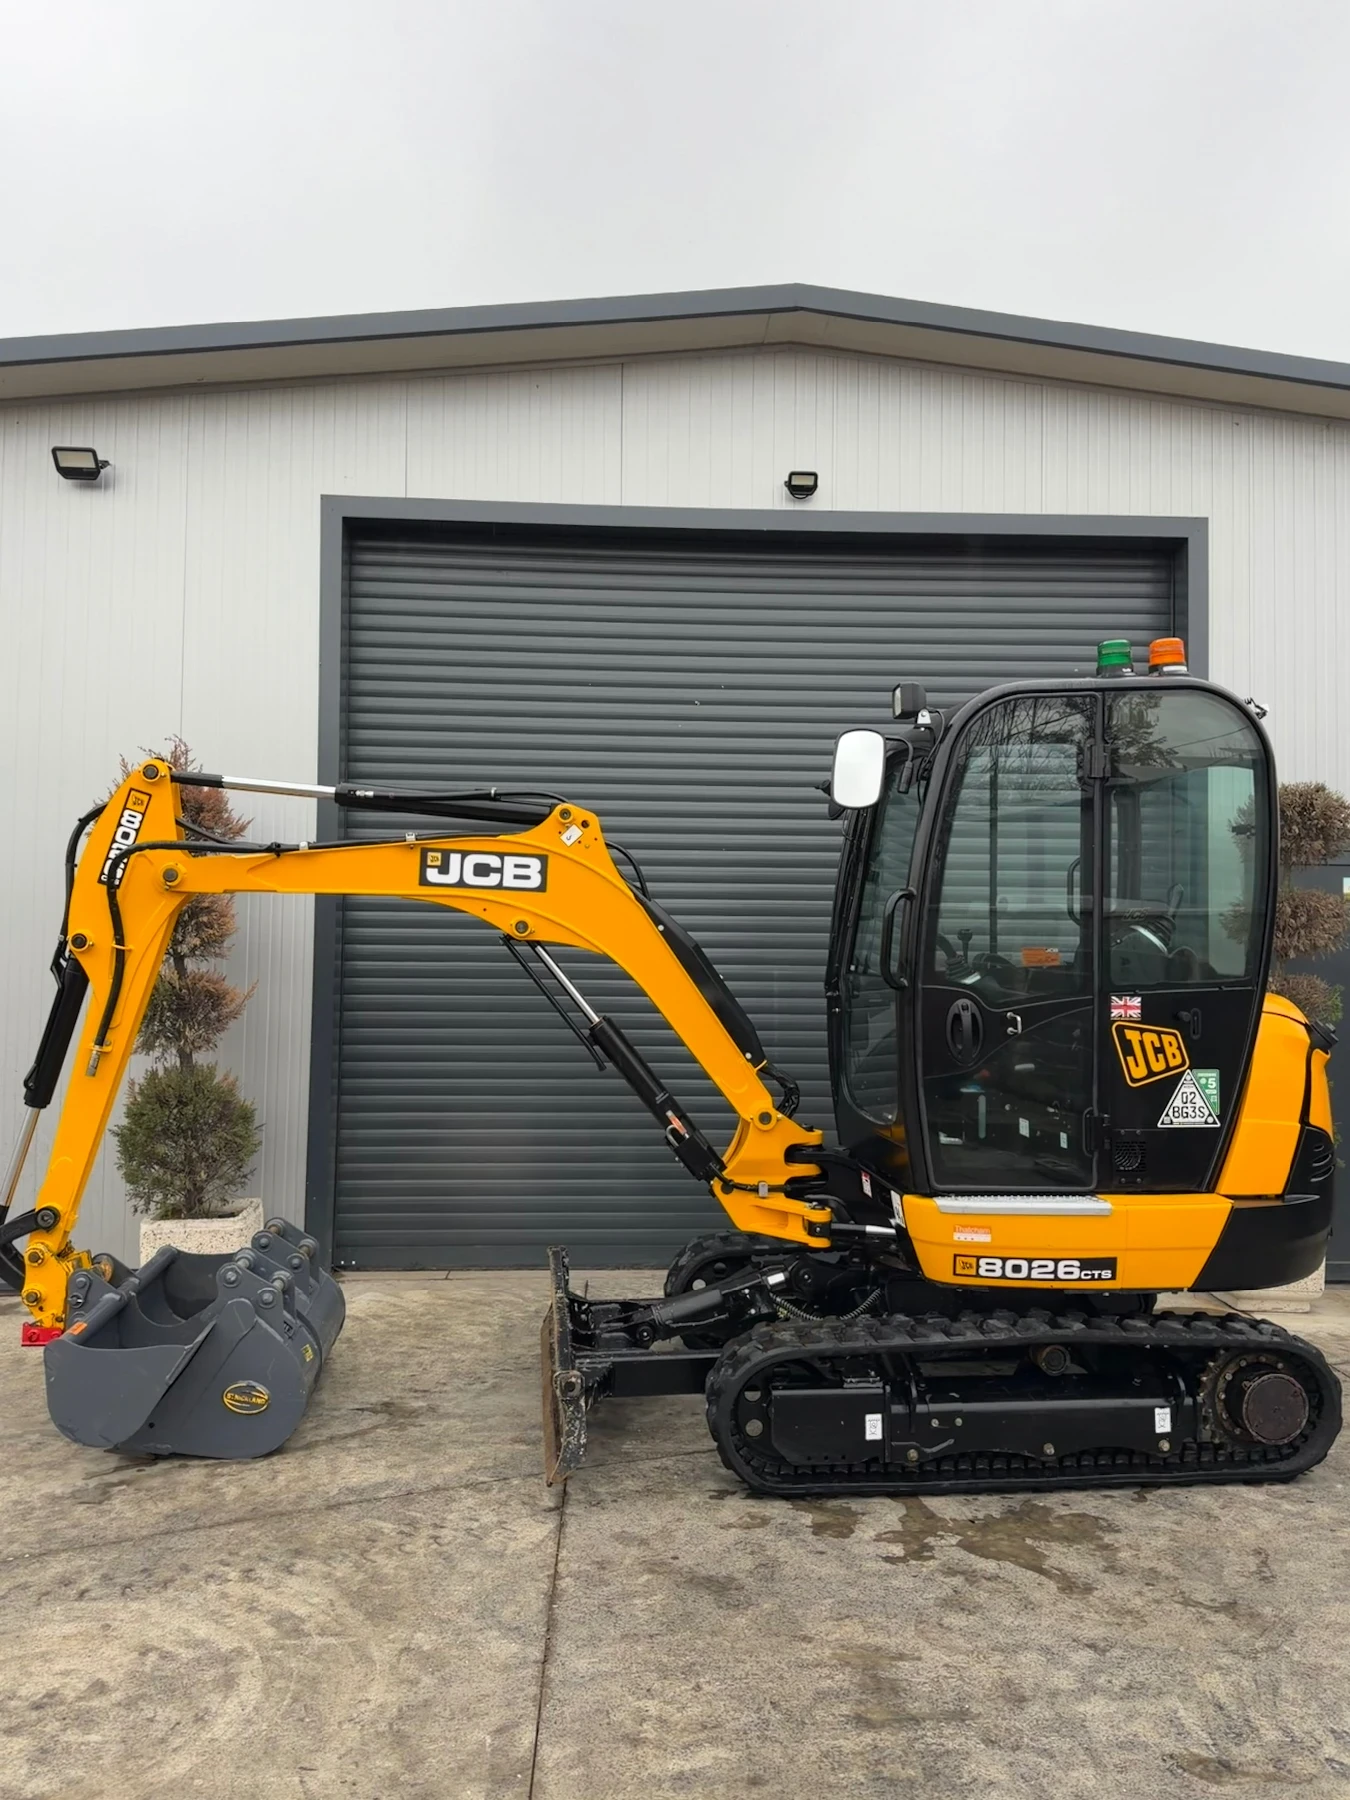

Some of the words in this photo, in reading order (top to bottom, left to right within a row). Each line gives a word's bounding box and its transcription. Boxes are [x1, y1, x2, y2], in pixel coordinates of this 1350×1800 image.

[426, 853, 542, 889] JCB
[1124, 1029, 1183, 1079] JCB
[1207, 1077, 1217, 1089] 5
[1172, 1105, 1206, 1119] BG3S
[955, 1224, 991, 1234] Thatcham
